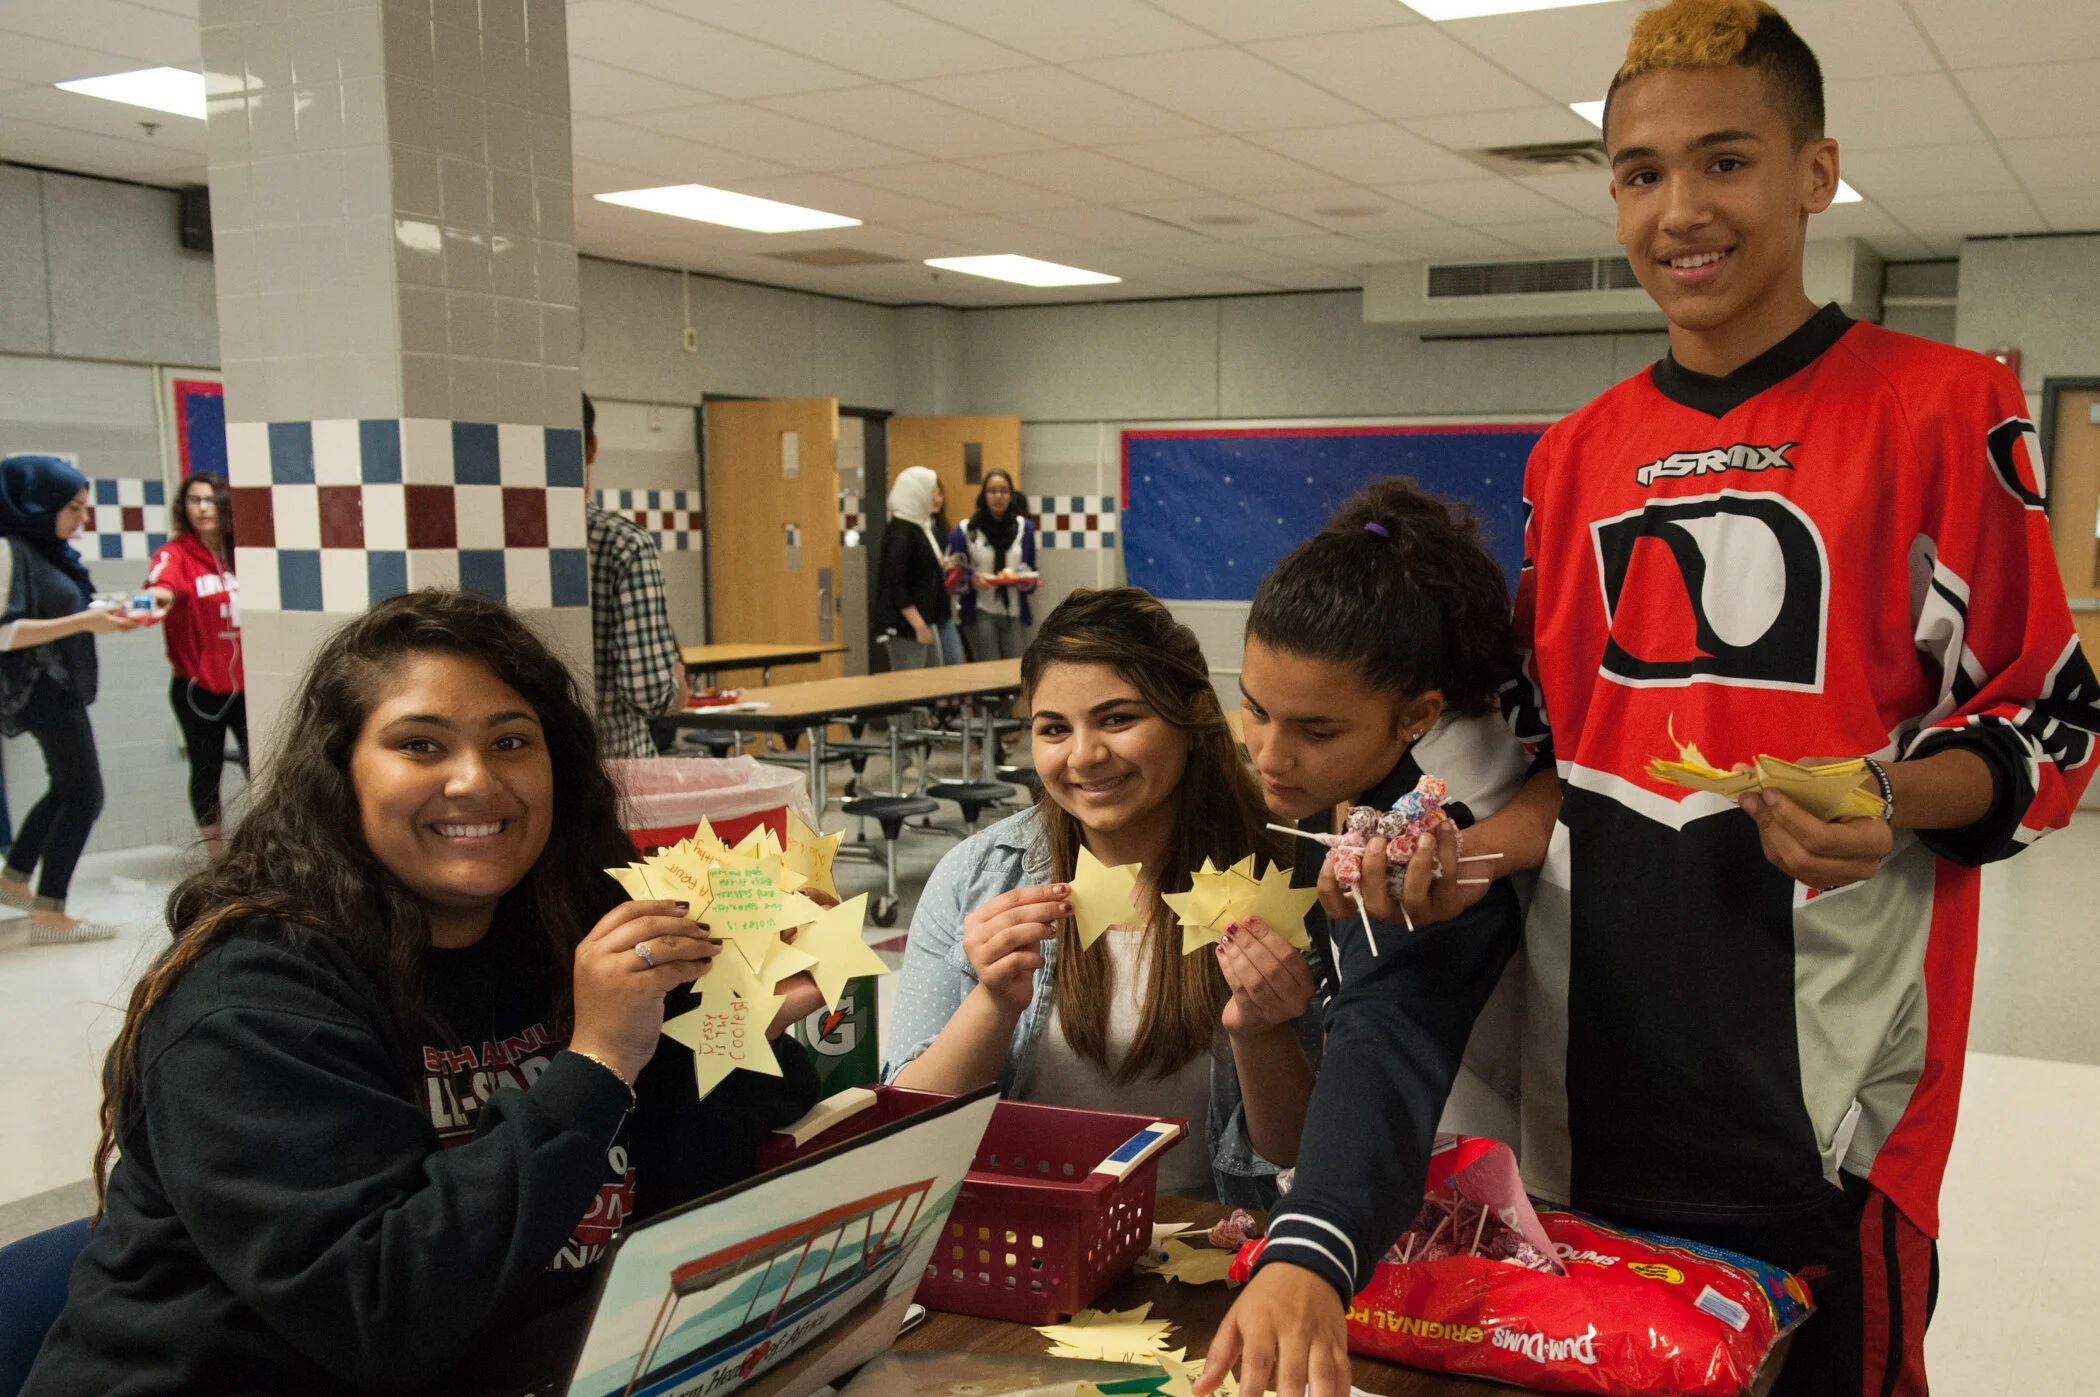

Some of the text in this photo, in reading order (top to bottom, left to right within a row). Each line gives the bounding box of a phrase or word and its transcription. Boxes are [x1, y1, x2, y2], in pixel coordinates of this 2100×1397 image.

[664, 864, 698, 890] FRUIT
[805, 996, 856, 1056] G
[714, 1042, 726, 1056] is
[1551, 1242, 1621, 1266] DUMS
[1345, 1305, 1370, 1325] PO
[1377, 1309, 1485, 1344] ORIGINAL
